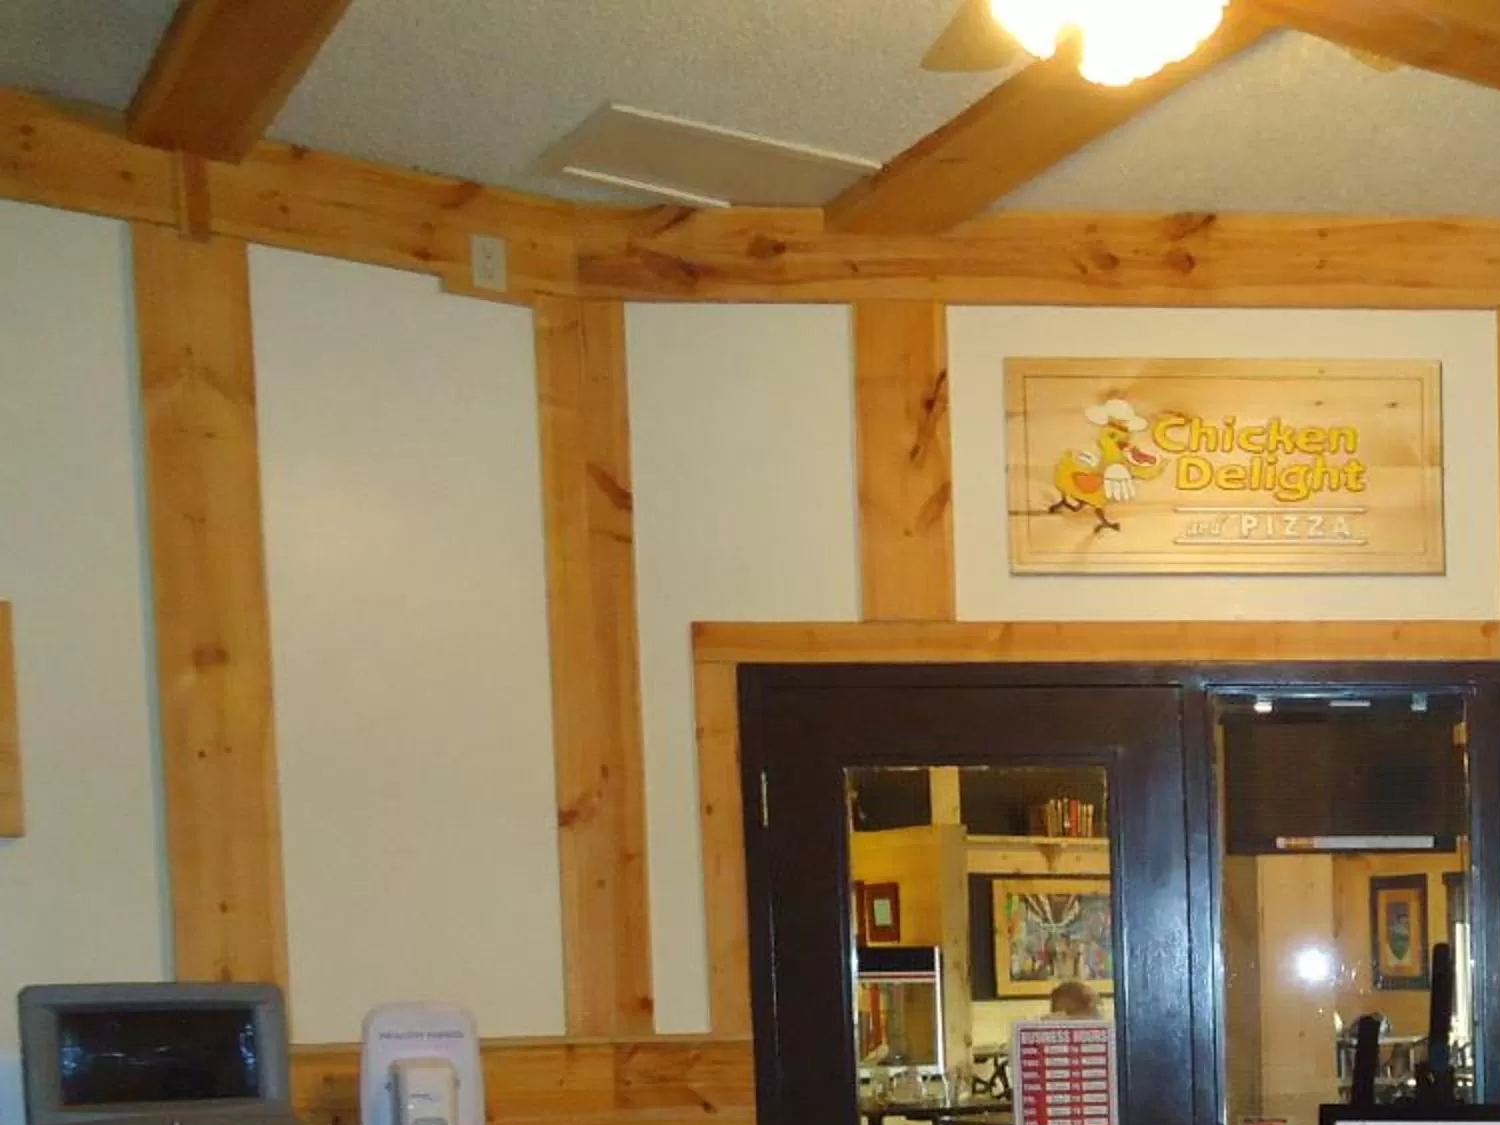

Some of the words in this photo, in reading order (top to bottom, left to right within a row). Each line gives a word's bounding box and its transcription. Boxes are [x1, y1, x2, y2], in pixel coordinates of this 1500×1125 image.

[1152, 416, 1359, 453] Chicken
[1175, 454, 1367, 502] Delight
[1239, 514, 1353, 537] PIZZA
